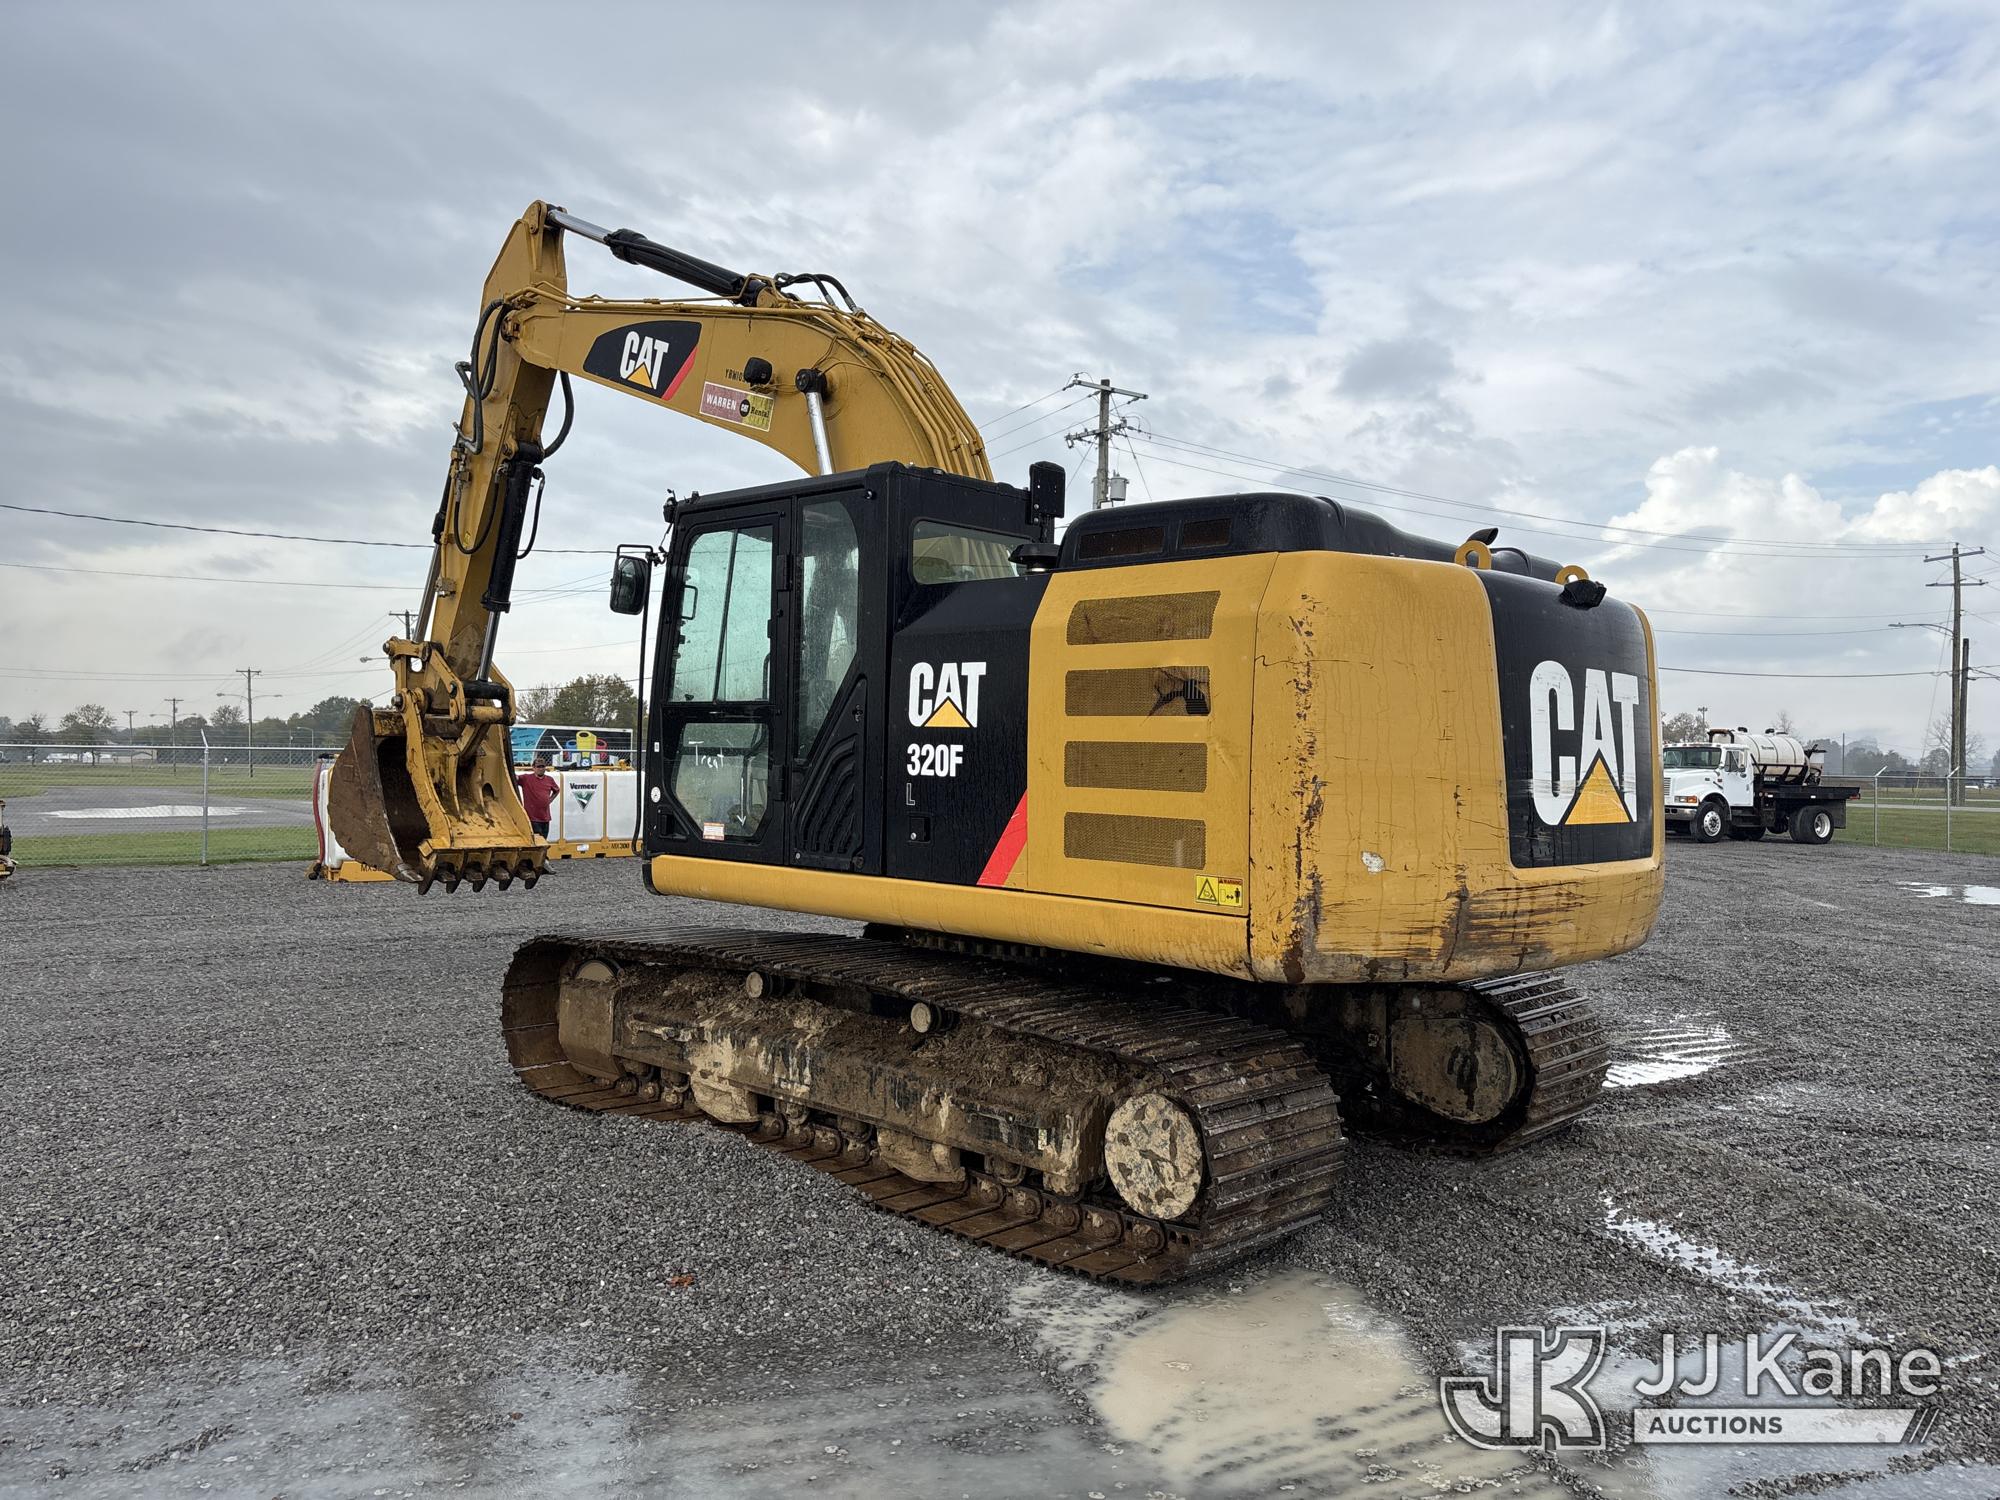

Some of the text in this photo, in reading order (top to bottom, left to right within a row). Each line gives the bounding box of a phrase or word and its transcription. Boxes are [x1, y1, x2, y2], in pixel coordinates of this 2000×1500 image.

[620, 331, 669, 389] CAT
[706, 393, 737, 411] WARREN
[750, 406, 770, 418] Rental
[908, 661, 987, 728] CAT
[906, 743, 964, 777] 320F
[1529, 660, 1640, 826] CAT
[906, 782, 916, 806] L
